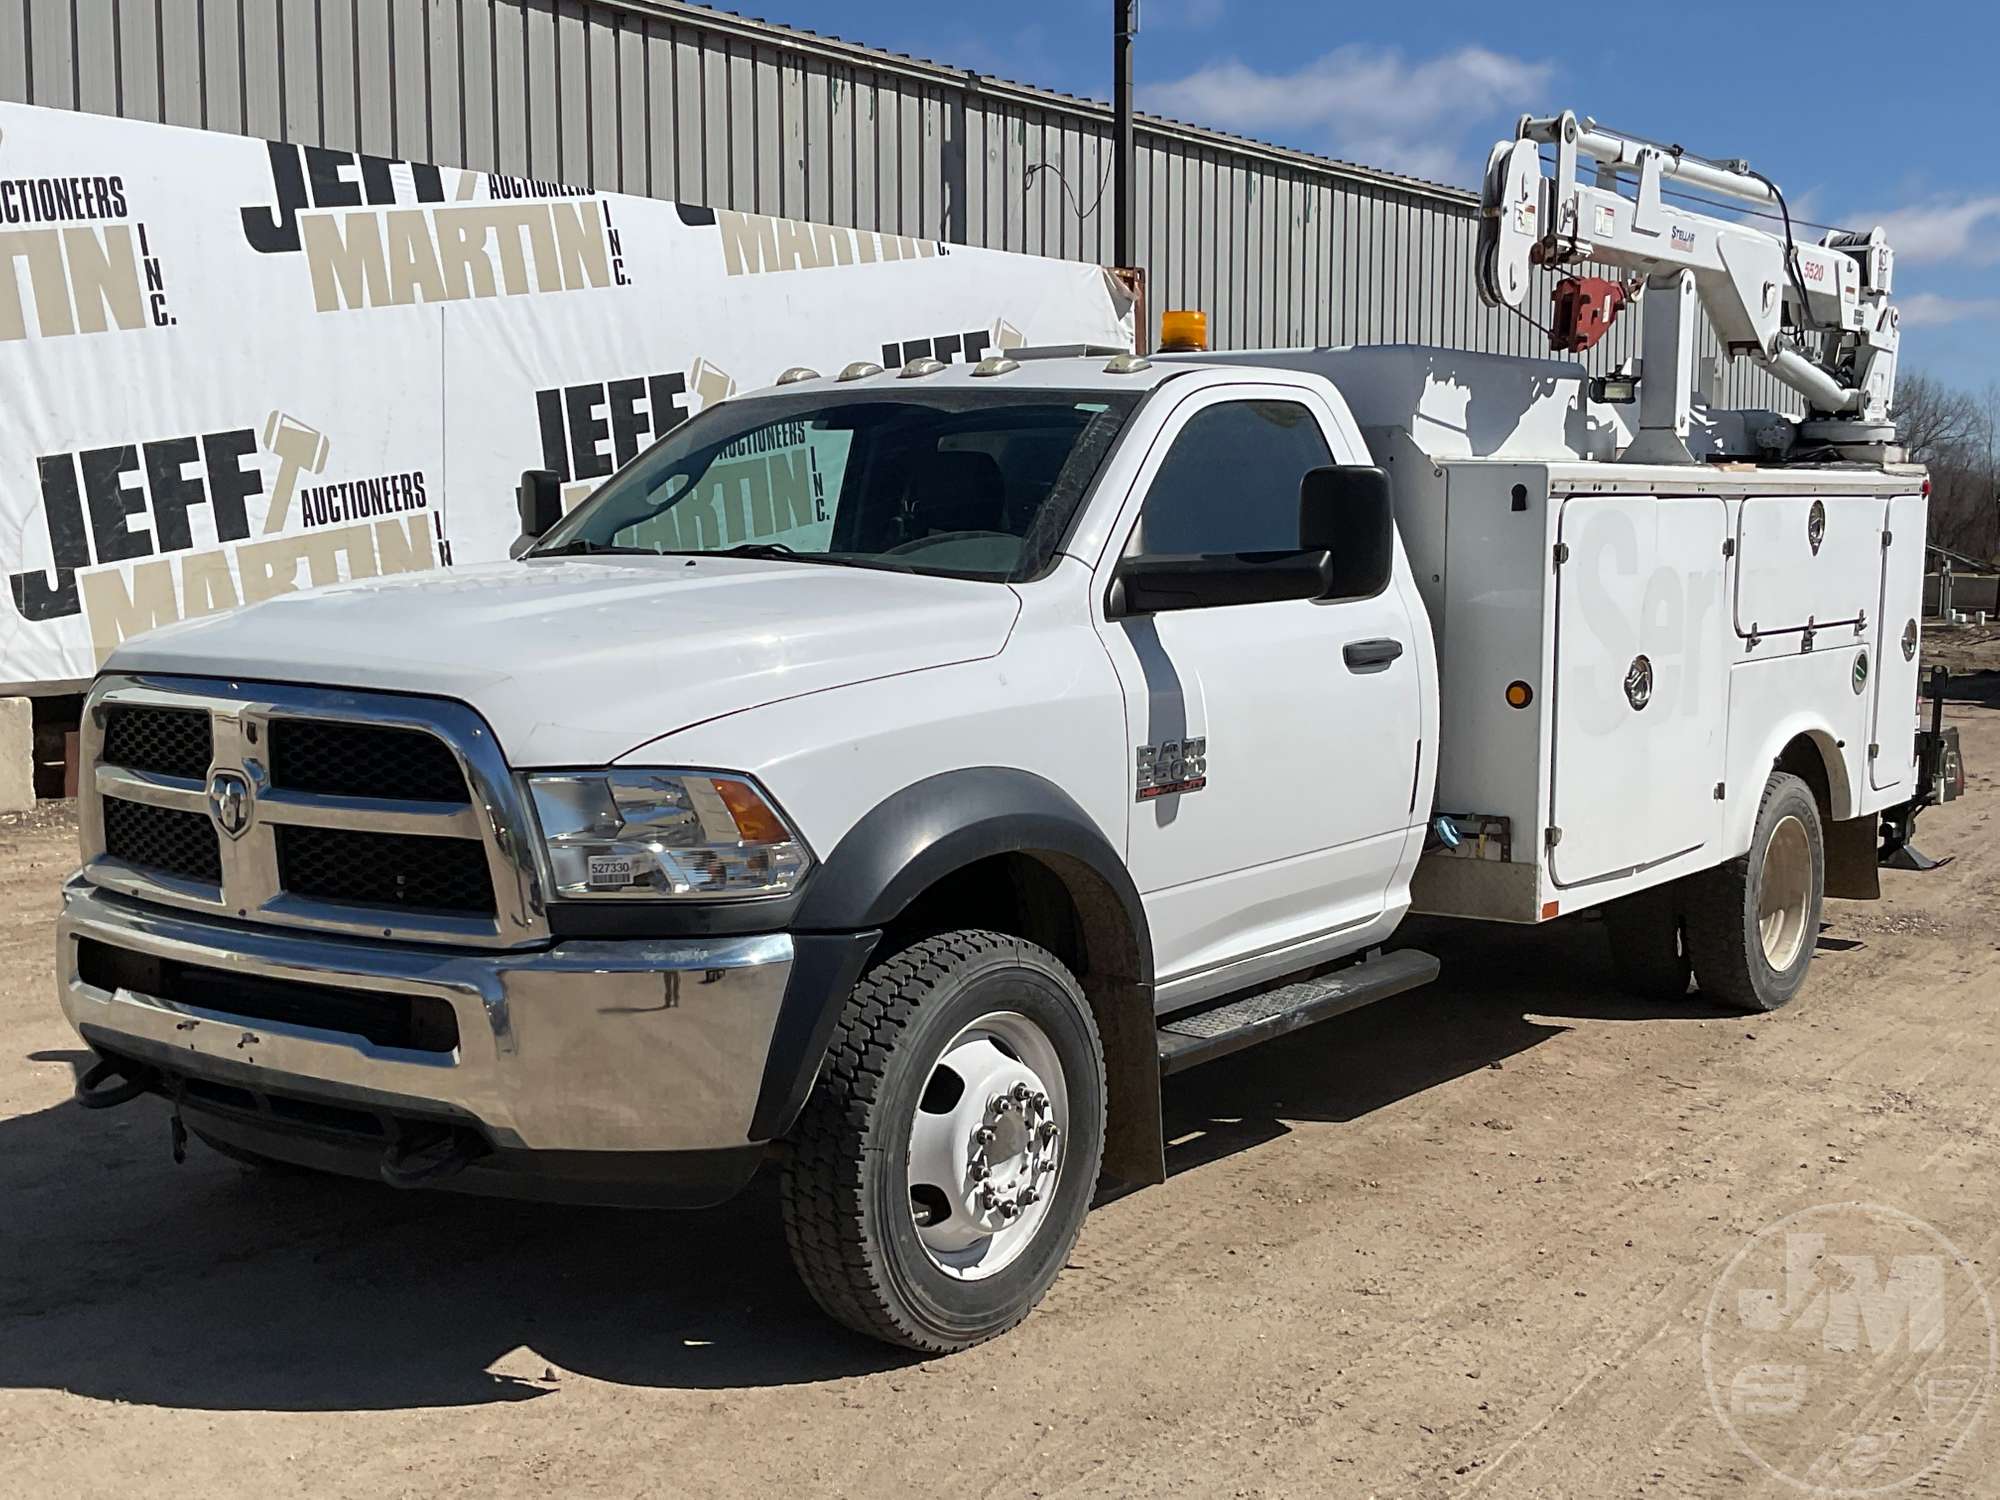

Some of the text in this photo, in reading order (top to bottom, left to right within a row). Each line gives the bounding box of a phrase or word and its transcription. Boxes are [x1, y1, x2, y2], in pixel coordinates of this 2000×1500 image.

[137, 223, 177, 327] INC.
[302, 201, 611, 312] MARTIN
[603, 200, 632, 285] INC.
[1804, 262, 1824, 282] 5520
[9, 428, 427, 622] JEFF AUCTIONEERS
[811, 446, 830, 522] INC.
[592, 862, 630, 874] 527330
